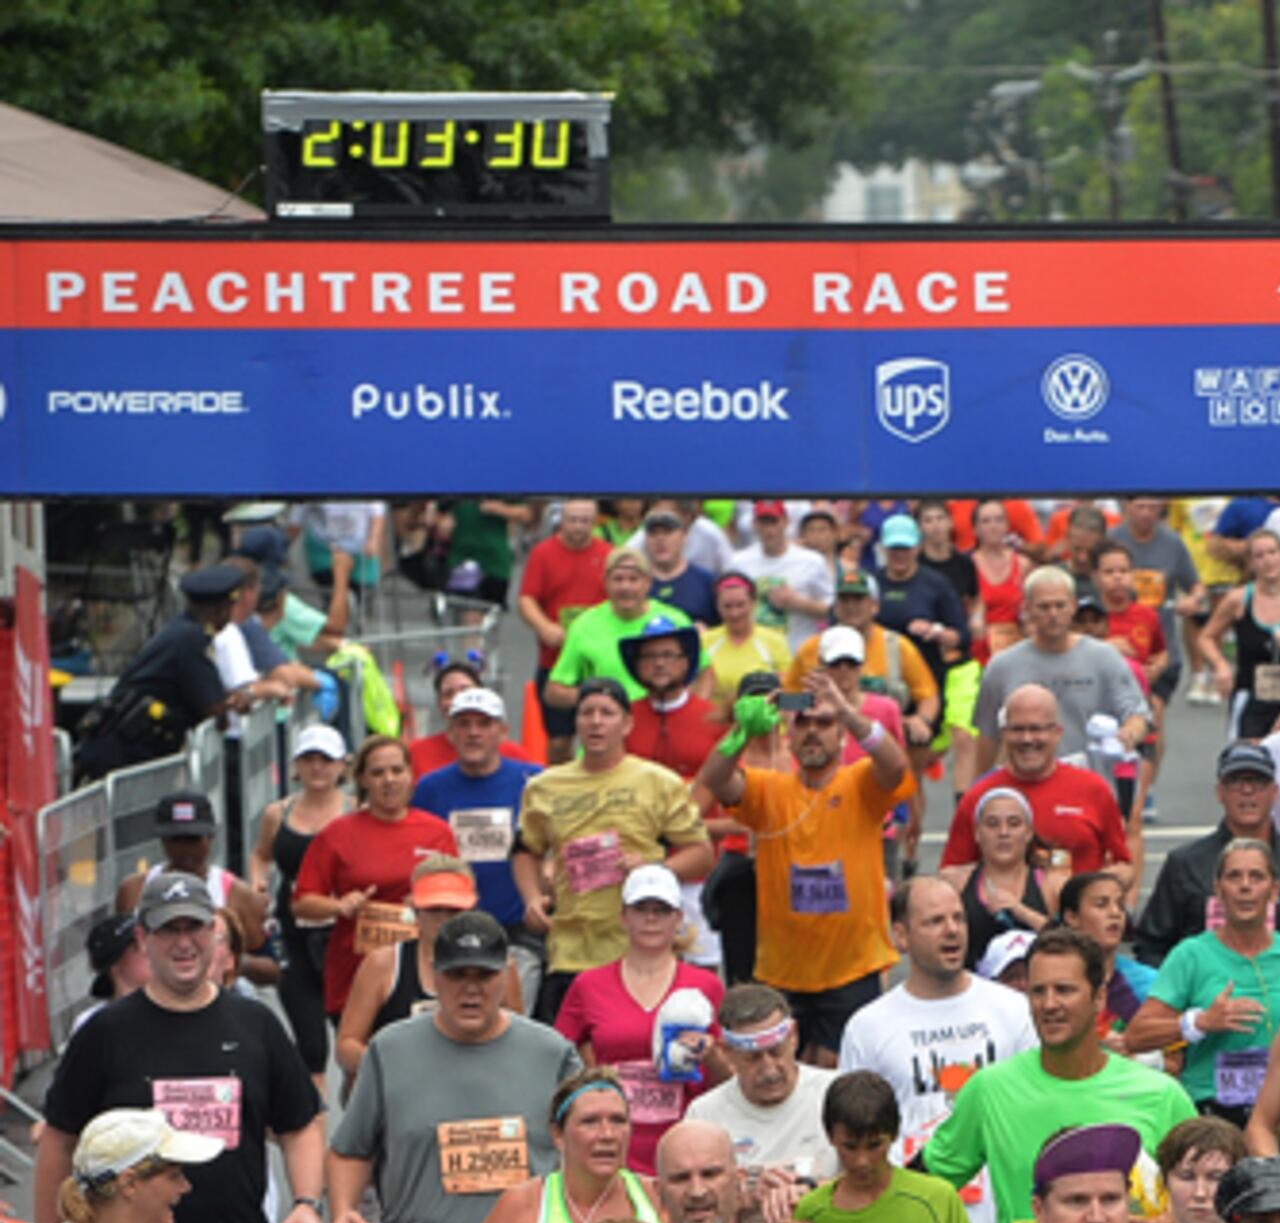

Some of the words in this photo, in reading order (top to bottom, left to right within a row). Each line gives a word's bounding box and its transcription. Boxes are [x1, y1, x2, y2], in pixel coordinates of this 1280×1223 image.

[47, 272, 515, 313] PEACHTREE
[561, 272, 767, 313] ROAD
[813, 271, 1010, 313] RACE
[48, 391, 250, 413] POWERADE
[613, 381, 789, 420] Reebok
[884, 384, 943, 429] ups
[911, 1027, 954, 1046] TEAM
[958, 1022, 992, 1041] UPS
[448, 1154, 462, 1172] H
